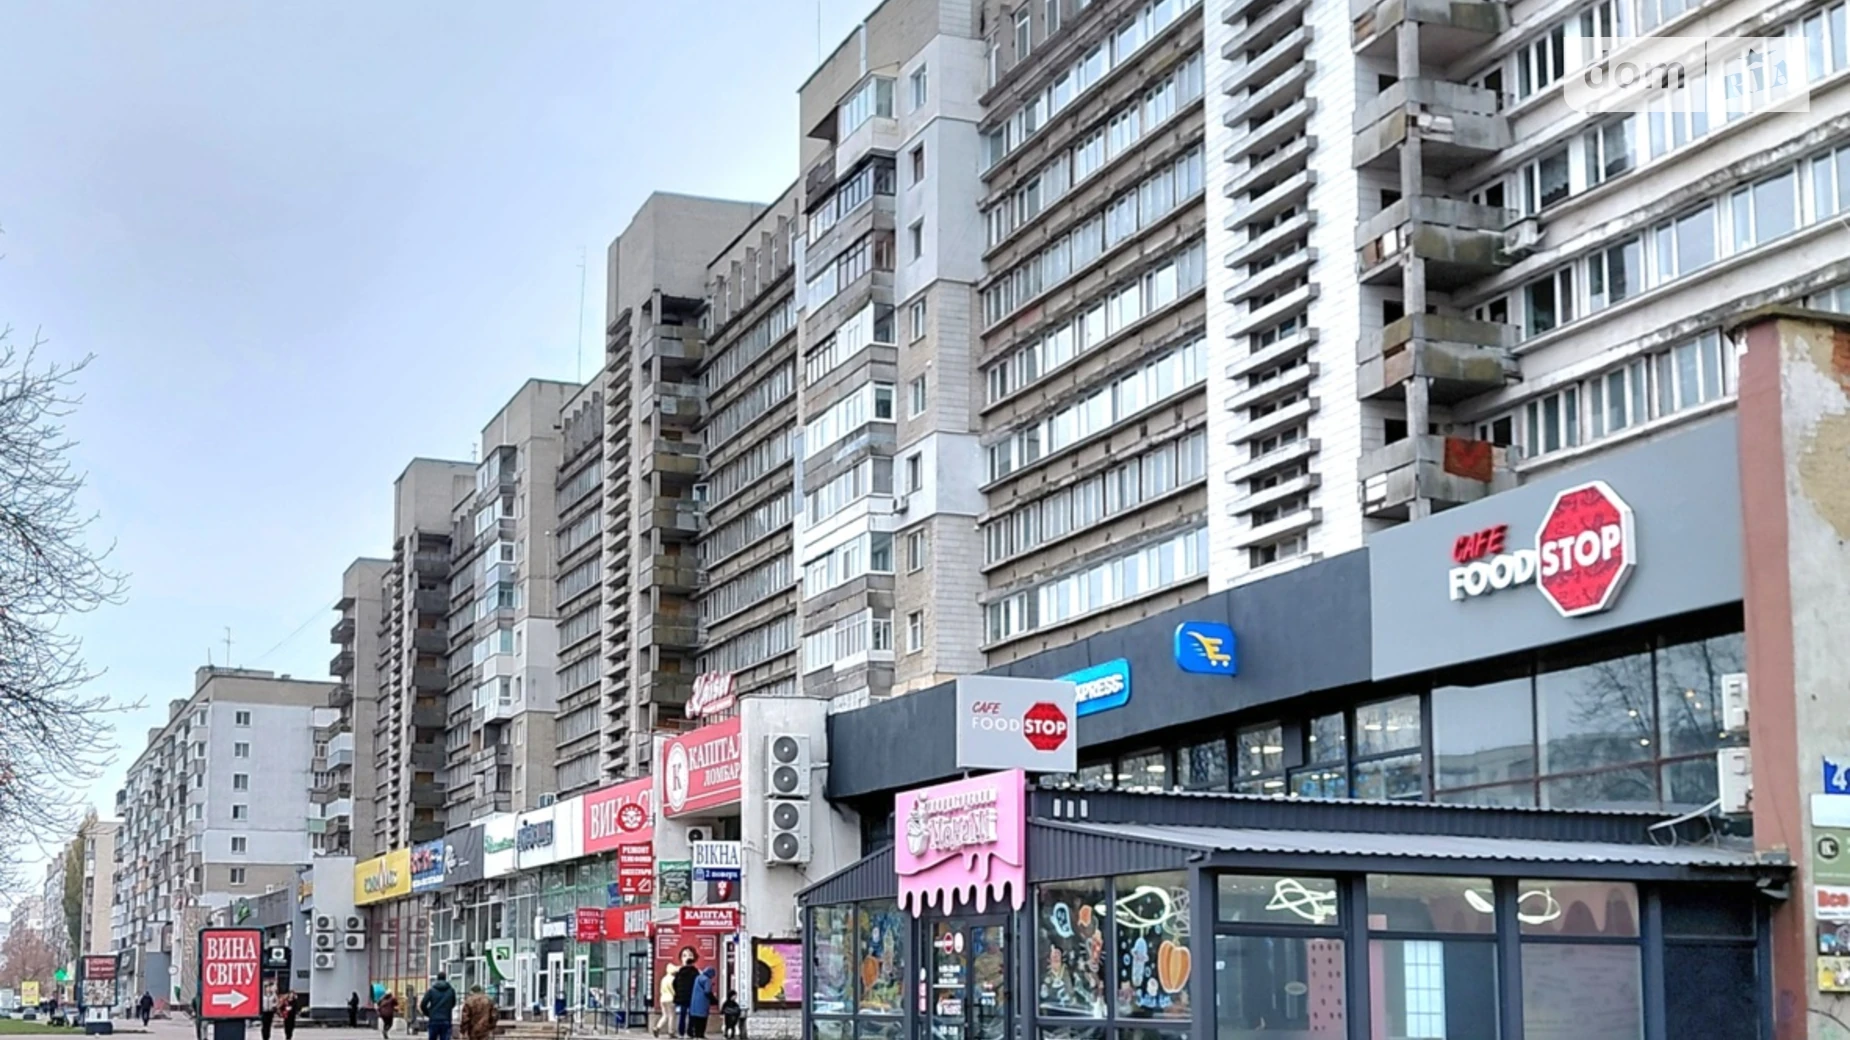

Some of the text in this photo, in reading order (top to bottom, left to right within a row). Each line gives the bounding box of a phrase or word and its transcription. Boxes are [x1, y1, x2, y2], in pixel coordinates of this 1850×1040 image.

[1453, 524, 1508, 563] CAFE
[1450, 524, 1621, 600] FOOD STOP
[972, 701, 1001, 715] CAFE
[972, 717, 1067, 735] FOOD STOP
[696, 844, 739, 865] ВІКНА
[685, 910, 733, 920] КАПІТАЛ
[206, 937, 257, 960] ВИНА
[206, 962, 257, 986] СВІТУ
